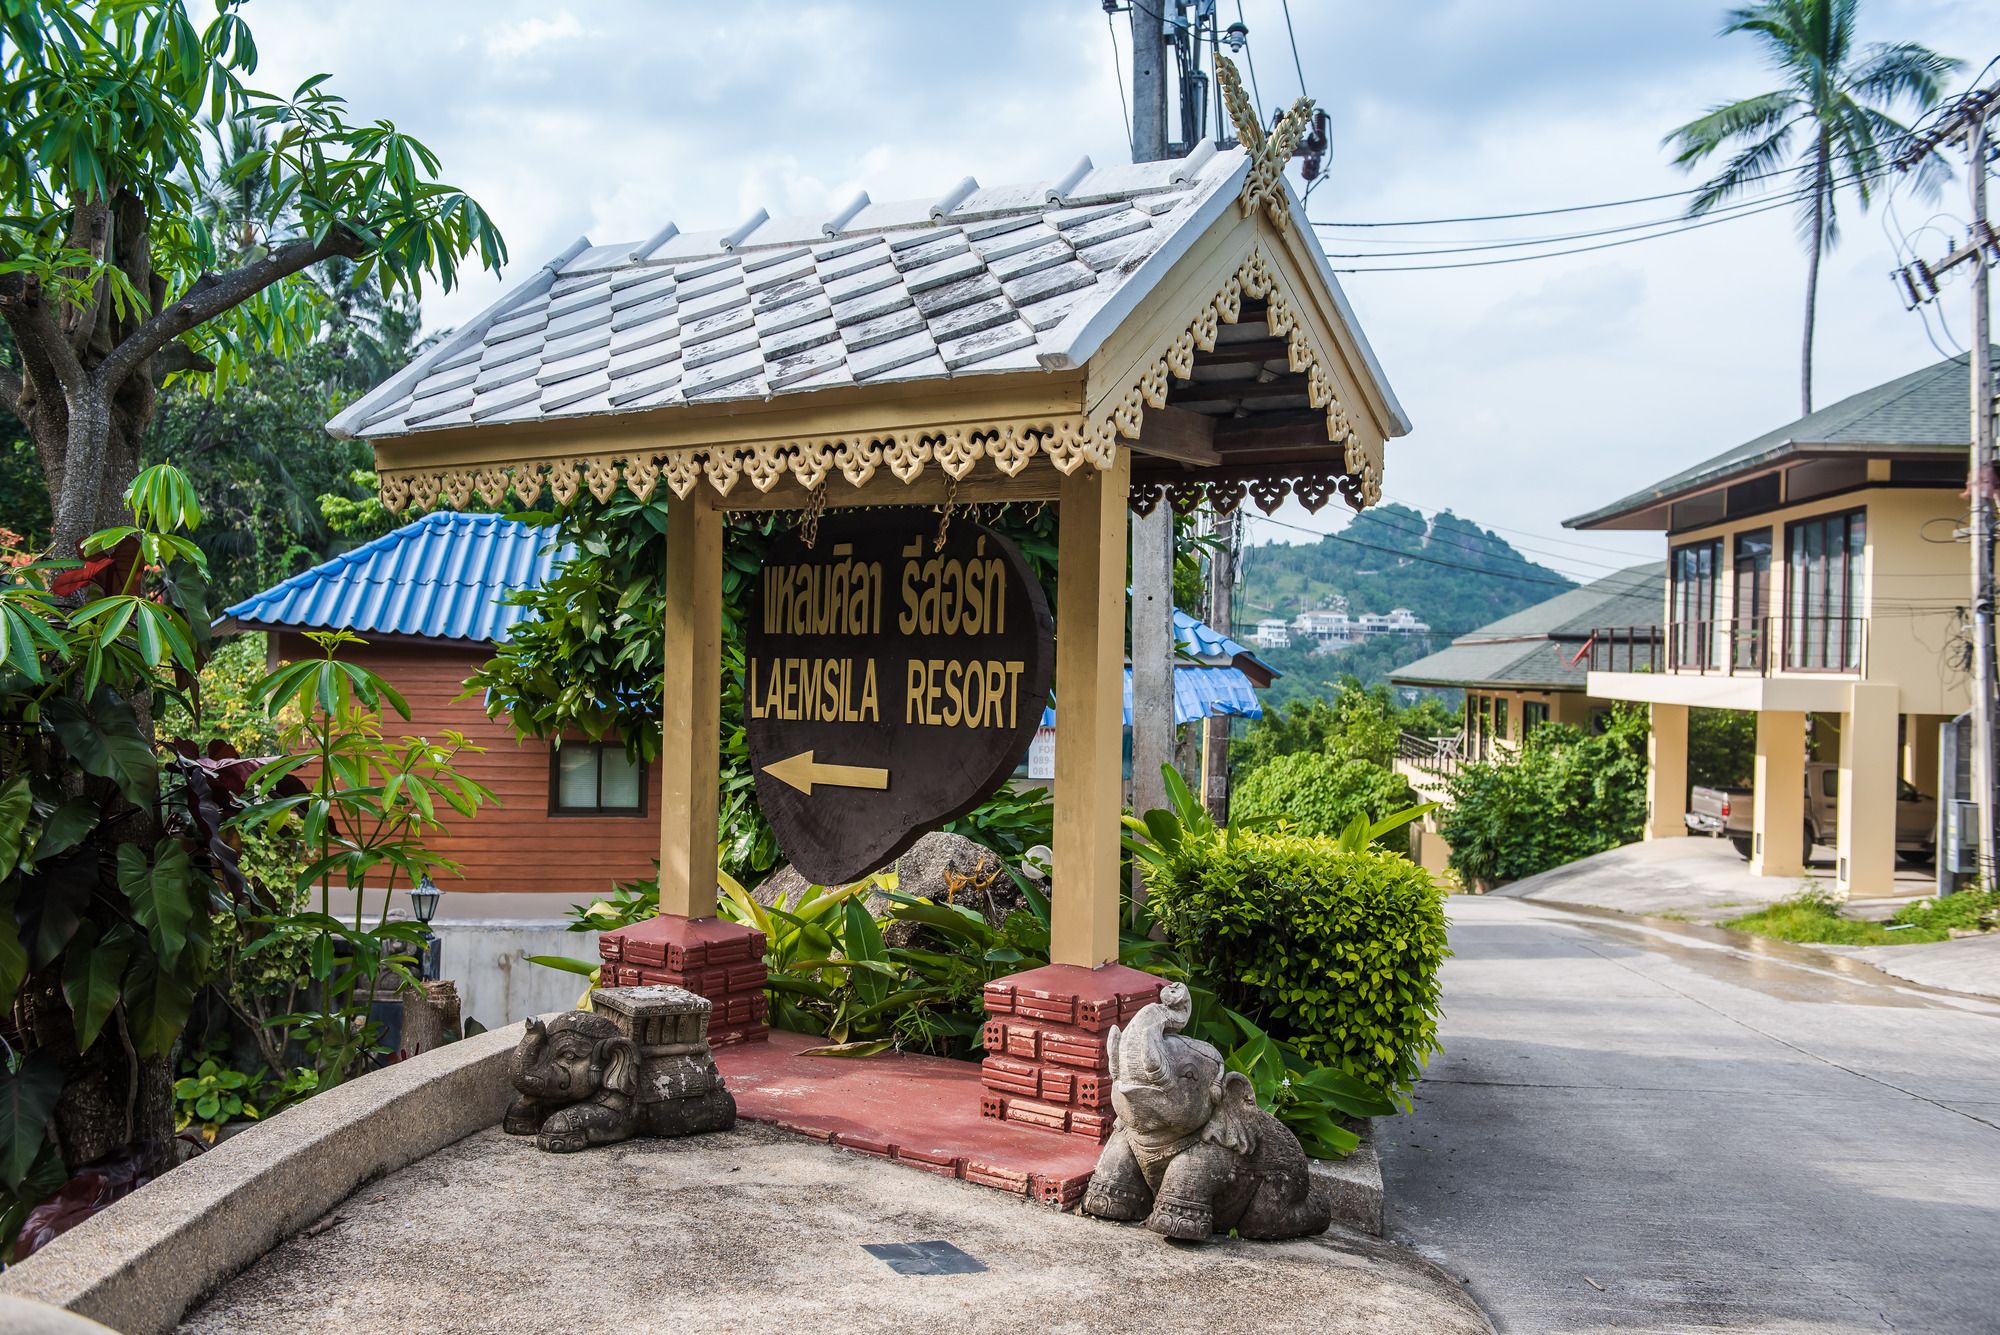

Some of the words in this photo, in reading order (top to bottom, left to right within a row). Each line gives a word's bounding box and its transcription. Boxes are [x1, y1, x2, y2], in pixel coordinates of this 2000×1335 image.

[764, 543, 881, 636] แหลมศิลา
[899, 534, 1006, 635] รีสอร์ท
[751, 657, 879, 722] LAEMSILA
[906, 659, 1025, 729] RESORT
